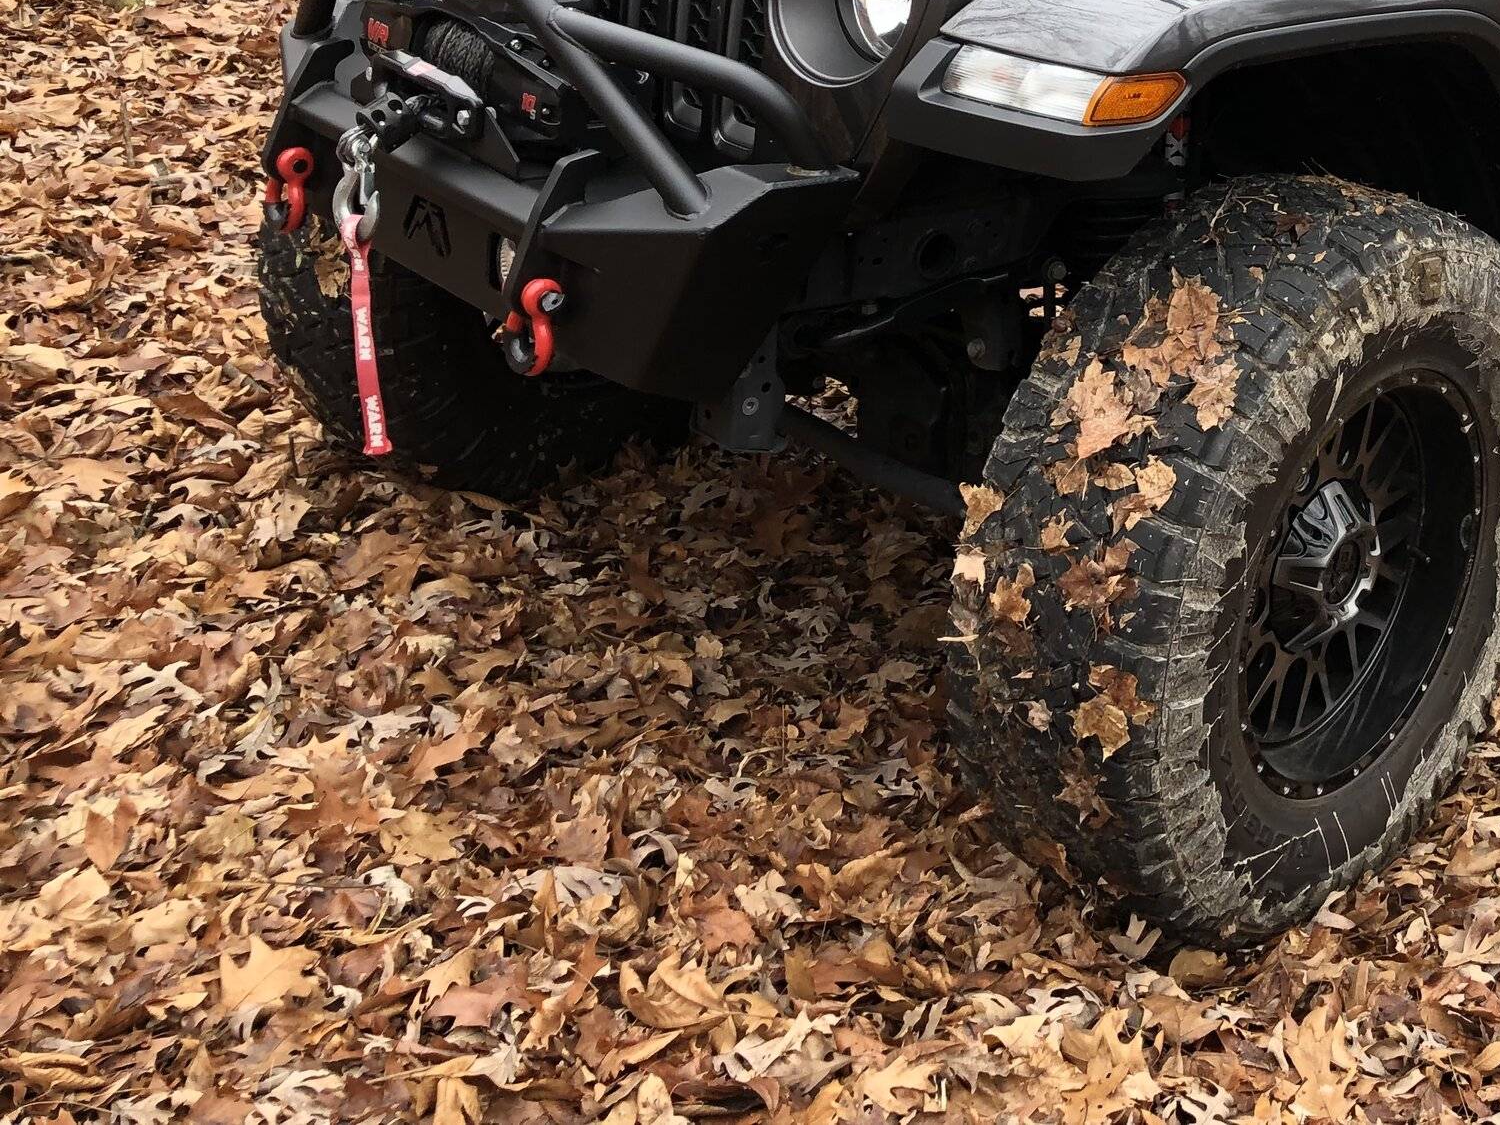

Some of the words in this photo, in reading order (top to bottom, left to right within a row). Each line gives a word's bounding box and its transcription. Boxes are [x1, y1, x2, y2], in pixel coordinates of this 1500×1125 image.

[521, 92, 537, 113] 10
[355, 306, 373, 361] WARN
[364, 394, 384, 448] WARN
